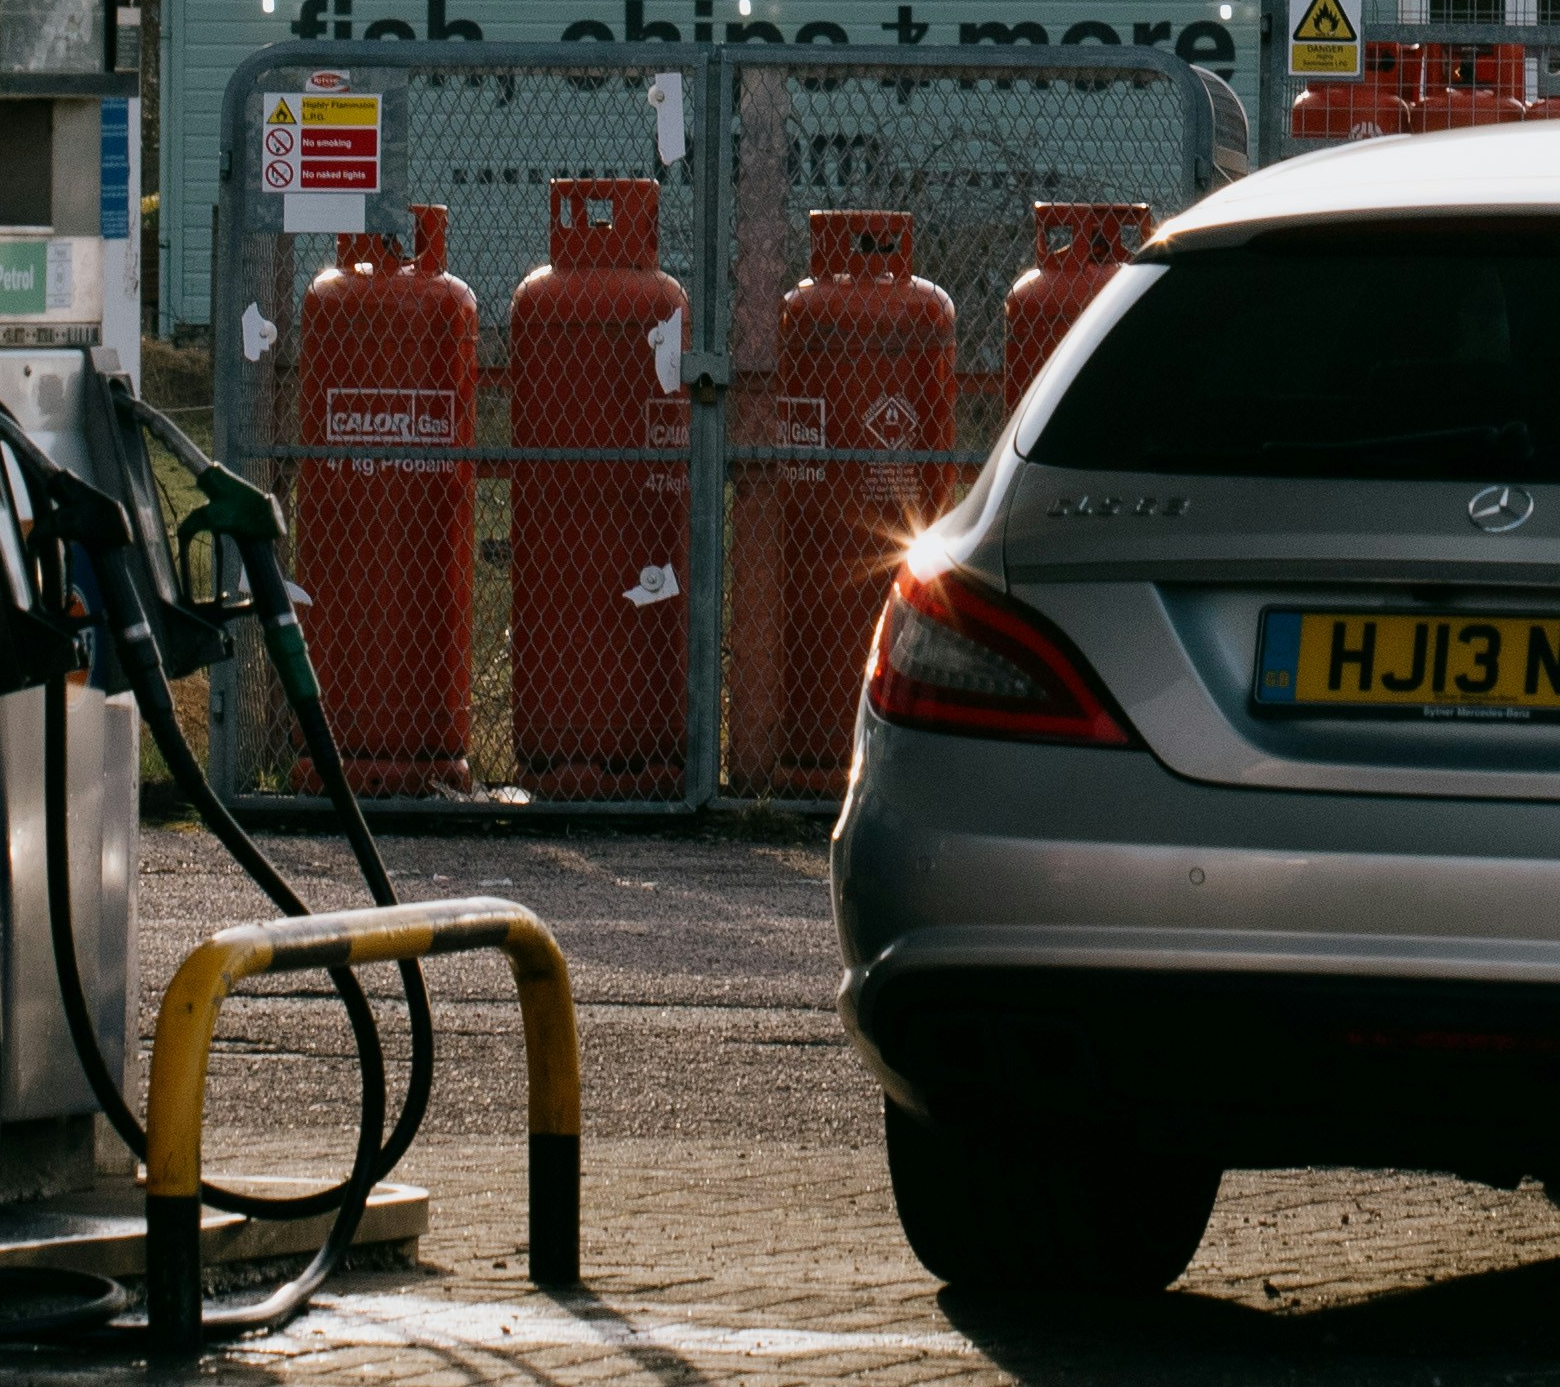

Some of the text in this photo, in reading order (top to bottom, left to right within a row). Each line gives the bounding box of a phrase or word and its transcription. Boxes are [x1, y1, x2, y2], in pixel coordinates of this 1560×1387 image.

[1307, 44, 1344, 53] DANGER
[302, 102, 329, 110] Highly
[302, 139, 352, 149] No smoking
[302, 171, 366, 182] No naked lights
[332, 412, 450, 440] CALOR Gas
[792, 422, 819, 443] Gas
[1327, 620, 1502, 694] HJ13
[1264, 669, 1290, 688] GB
